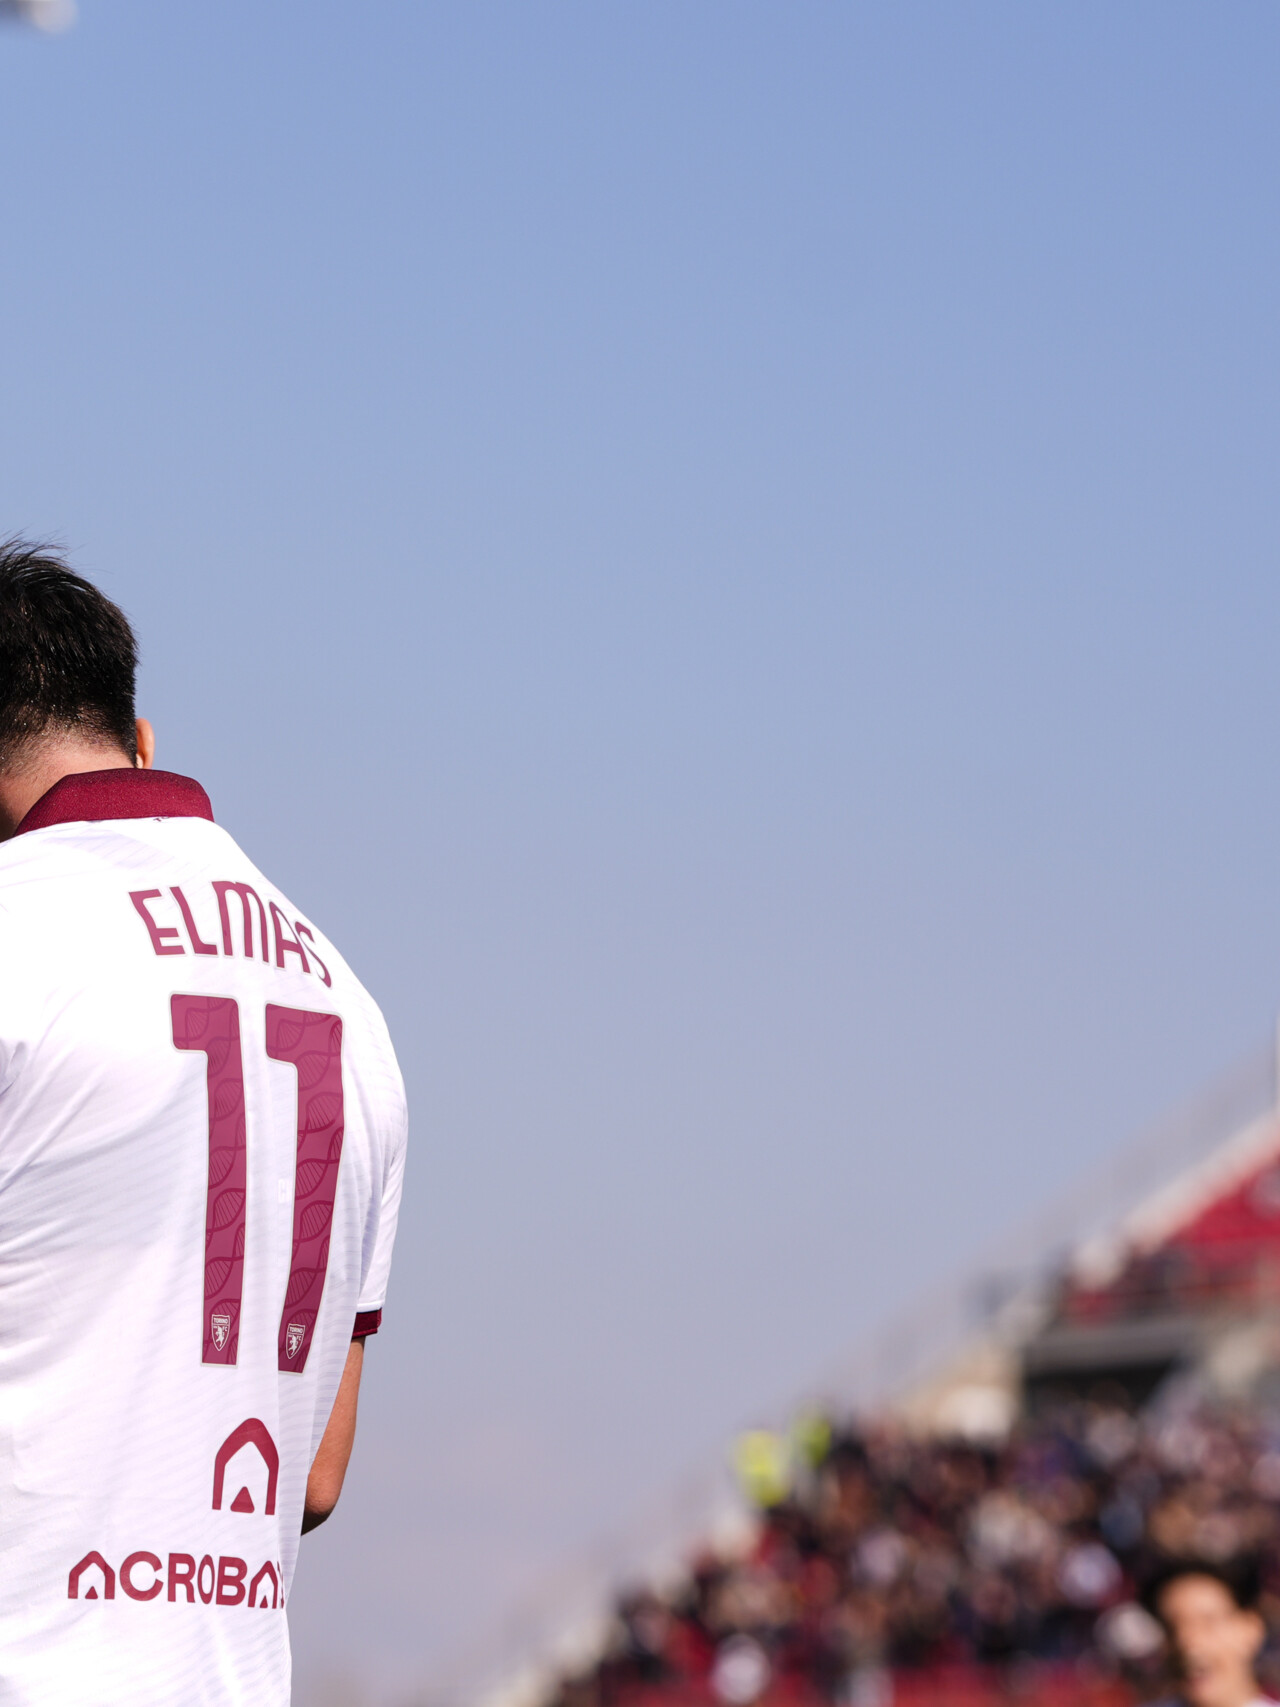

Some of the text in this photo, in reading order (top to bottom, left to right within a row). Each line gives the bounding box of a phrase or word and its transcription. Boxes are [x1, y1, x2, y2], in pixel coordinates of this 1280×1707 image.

[128, 880, 332, 989] ELMAS
[170, 993, 345, 1374] 11
[67, 1550, 284, 1609] ACROBA
